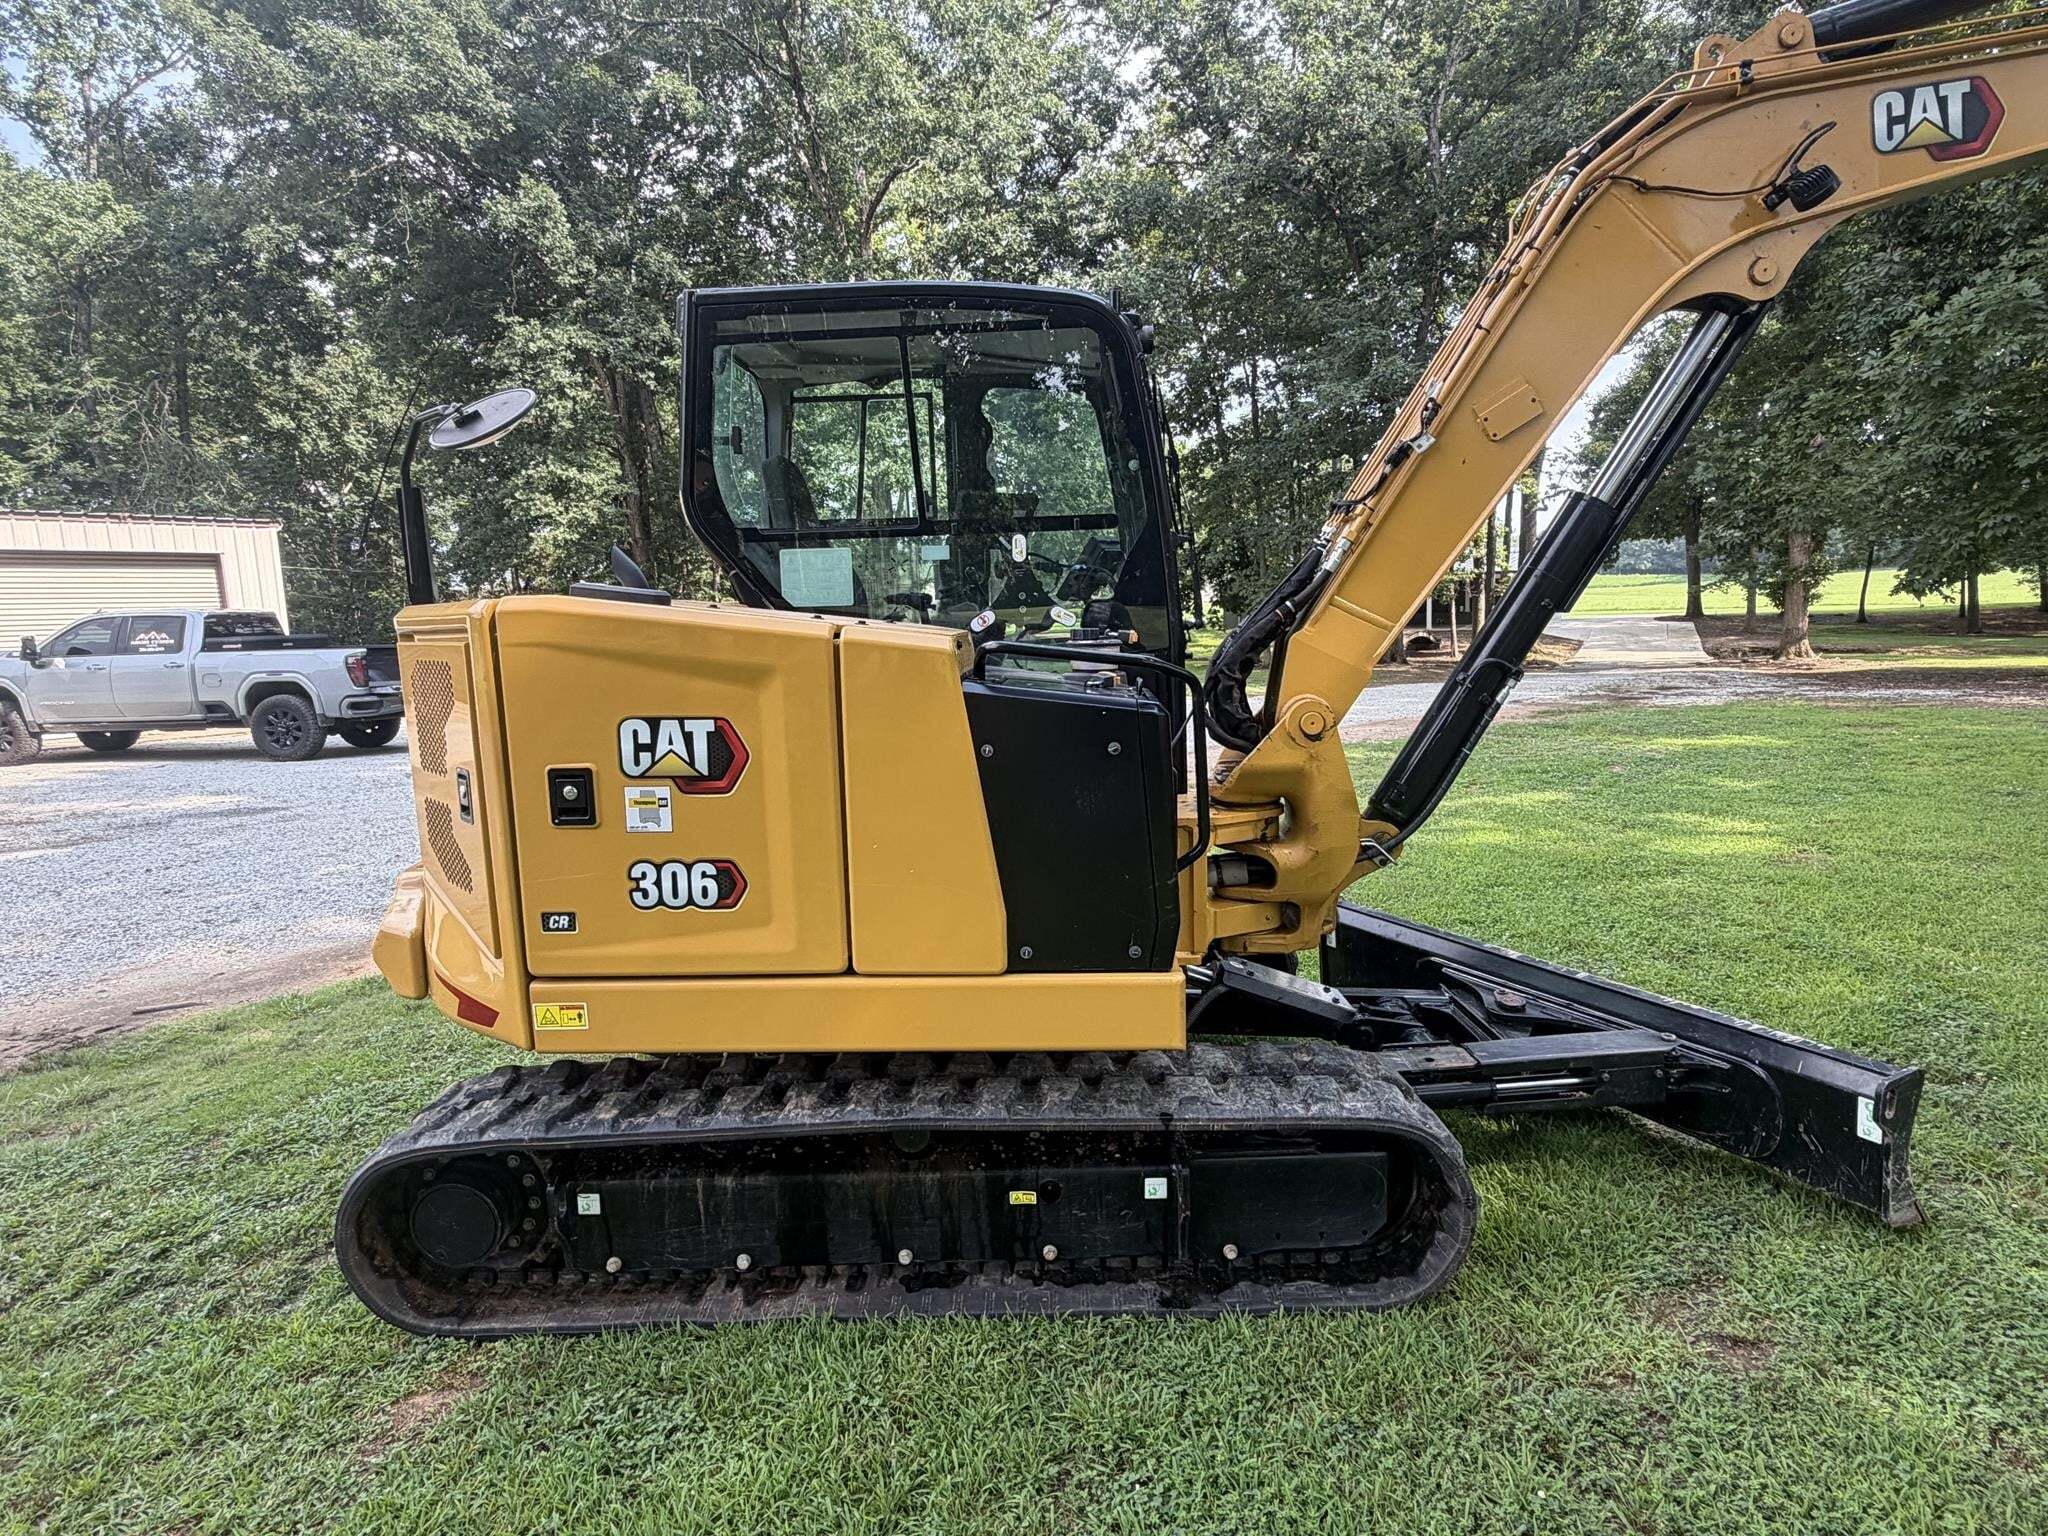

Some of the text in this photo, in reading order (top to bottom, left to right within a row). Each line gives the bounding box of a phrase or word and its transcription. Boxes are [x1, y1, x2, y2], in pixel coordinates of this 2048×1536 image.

[1873, 79, 1971, 152] CAT
[619, 718, 716, 777] CAT
[630, 862, 719, 907] 306
[549, 915, 570, 929] CR
